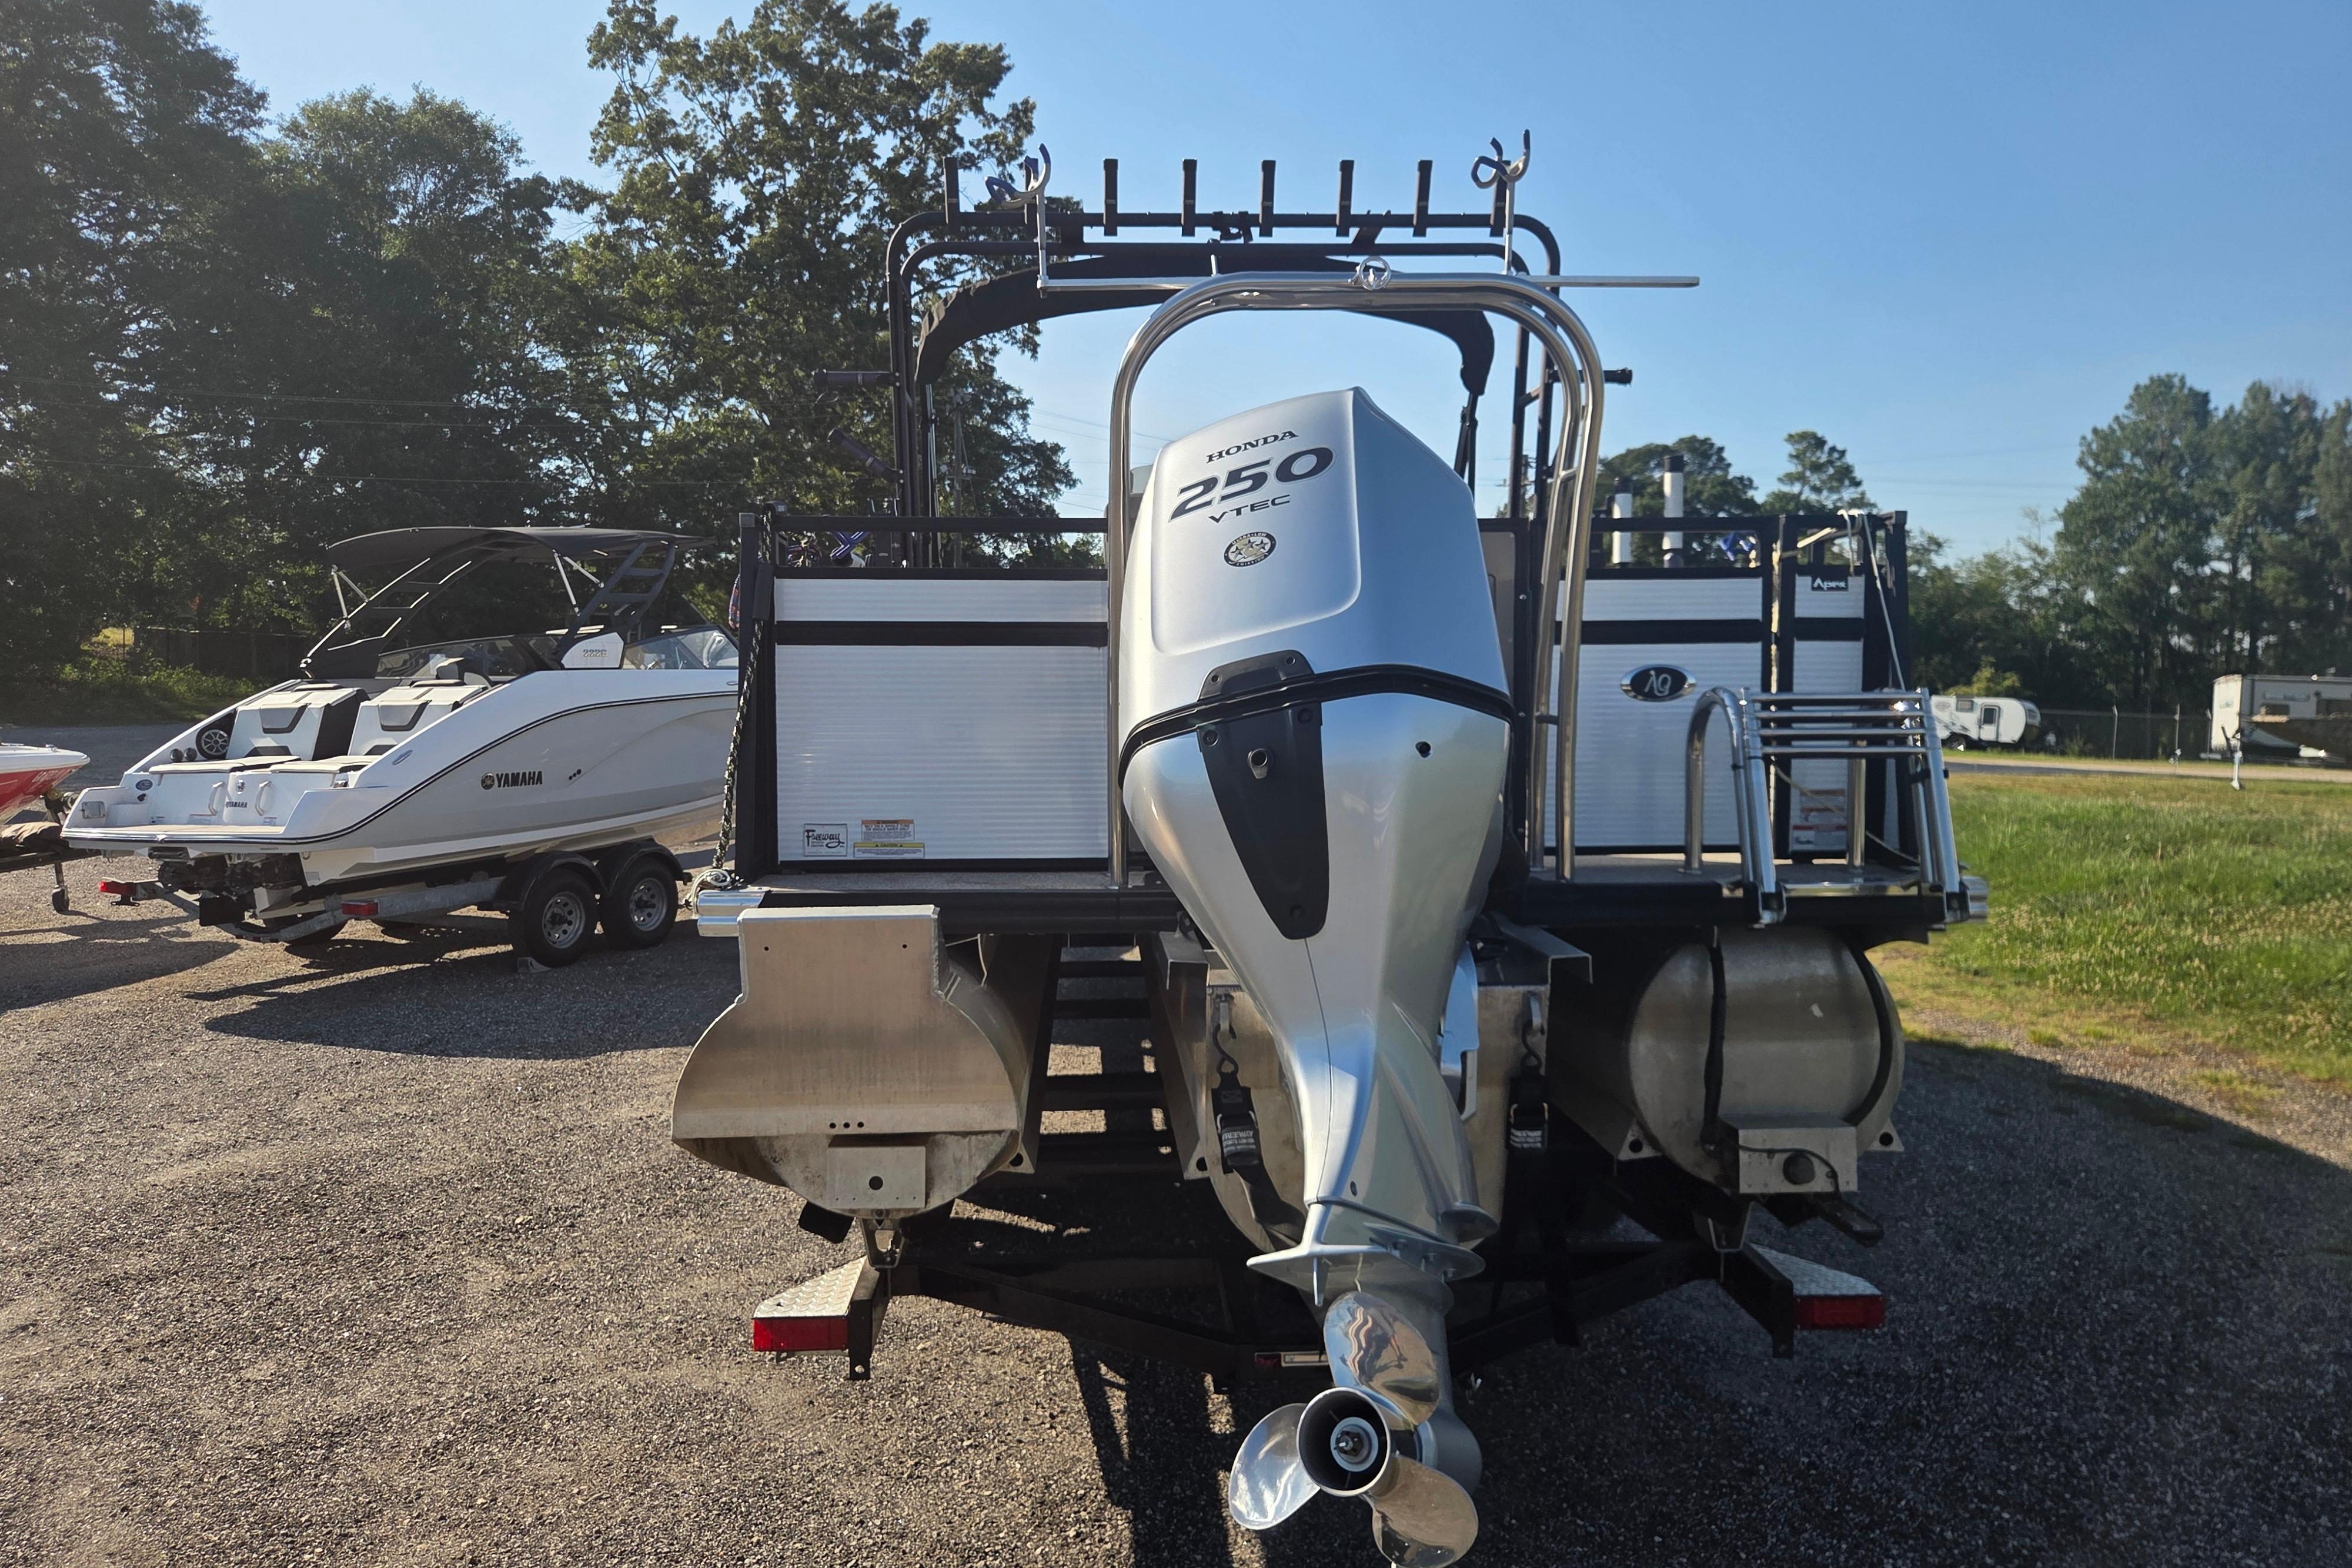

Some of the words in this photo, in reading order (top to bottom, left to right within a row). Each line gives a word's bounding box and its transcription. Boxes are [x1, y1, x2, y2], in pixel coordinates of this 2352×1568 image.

[1206, 430, 1299, 464] HONDA
[1170, 447, 1334, 521] 250
[1208, 494, 1290, 523] VTEC
[496, 771, 543, 788] YAMAHA
[805, 829, 845, 848] Freeway
[1222, 1130, 1254, 1141] FREEWAY
